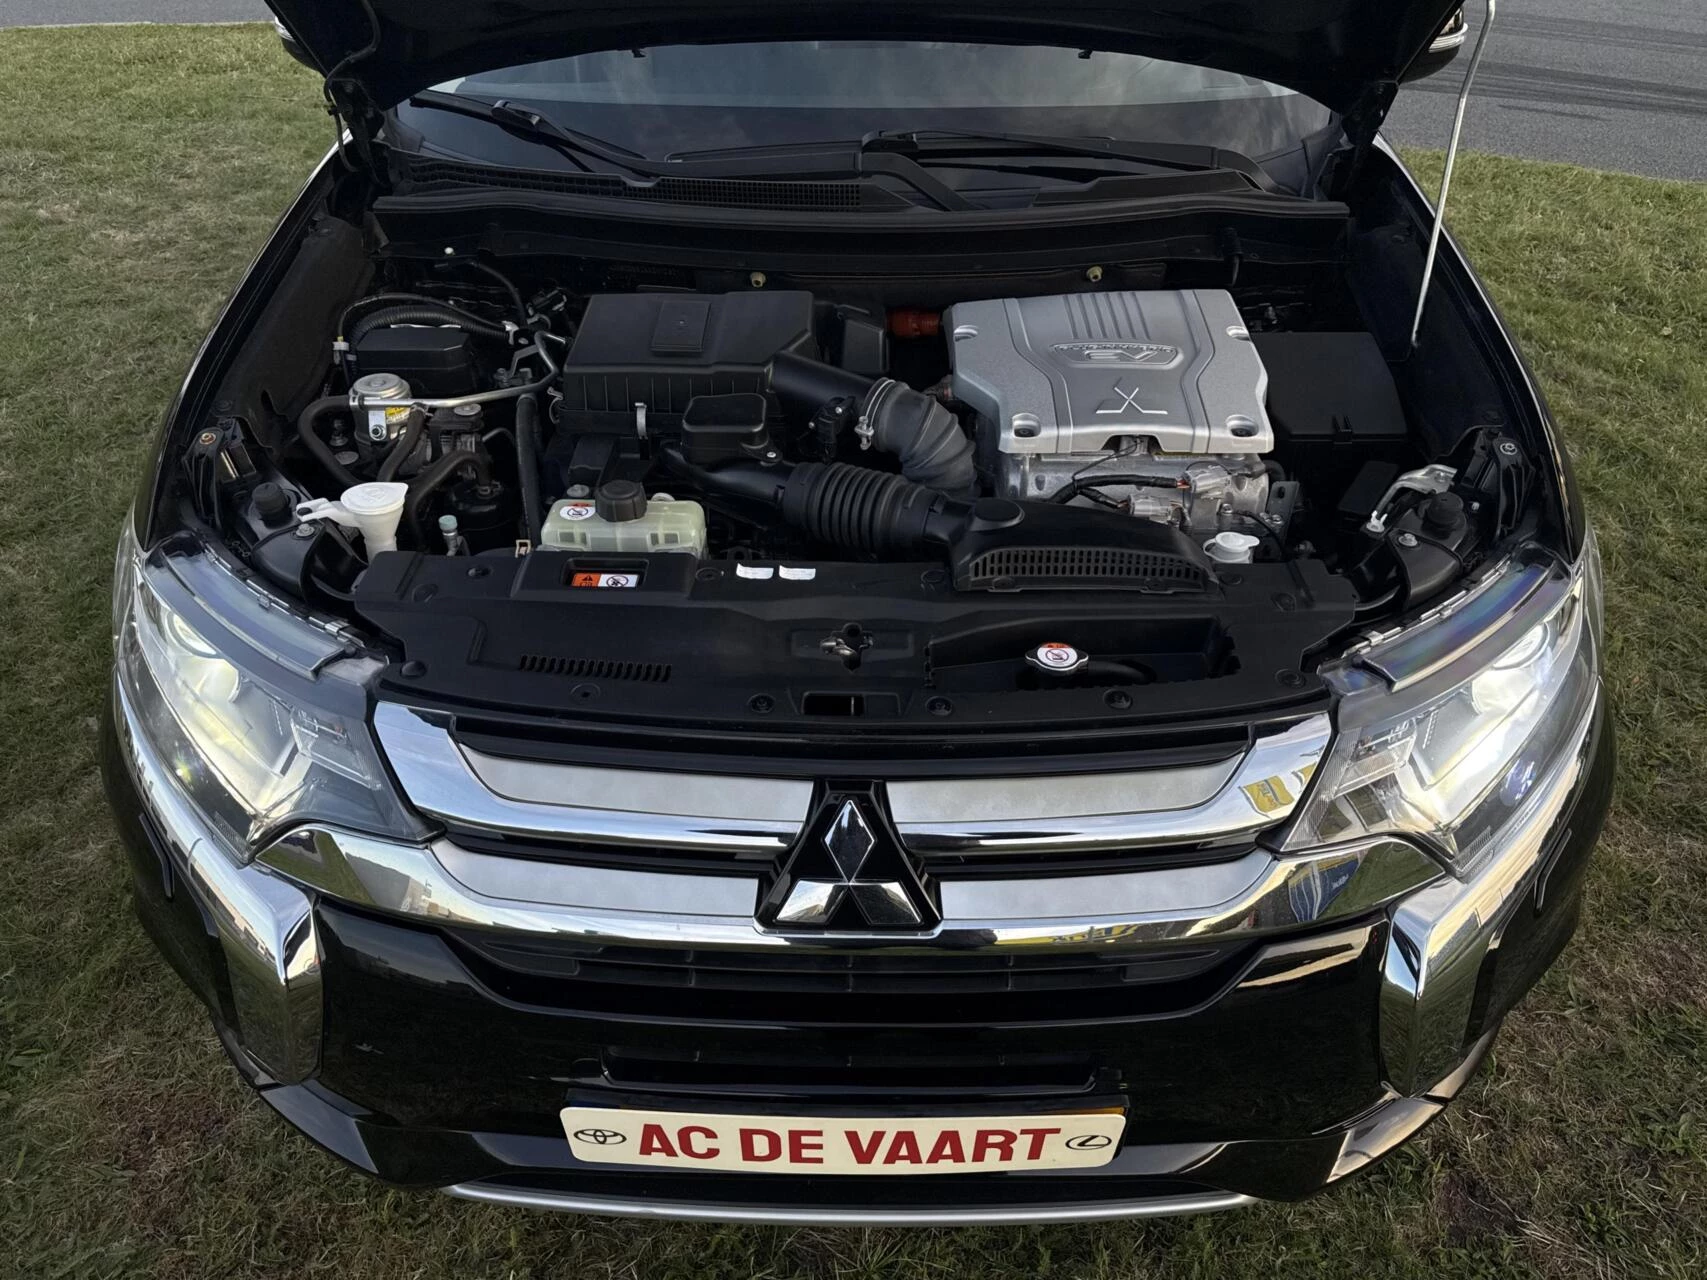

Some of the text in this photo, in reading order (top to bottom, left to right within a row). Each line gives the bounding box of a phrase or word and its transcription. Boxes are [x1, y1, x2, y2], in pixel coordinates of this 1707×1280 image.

[639, 1123, 1061, 1165] AC DE VAART
